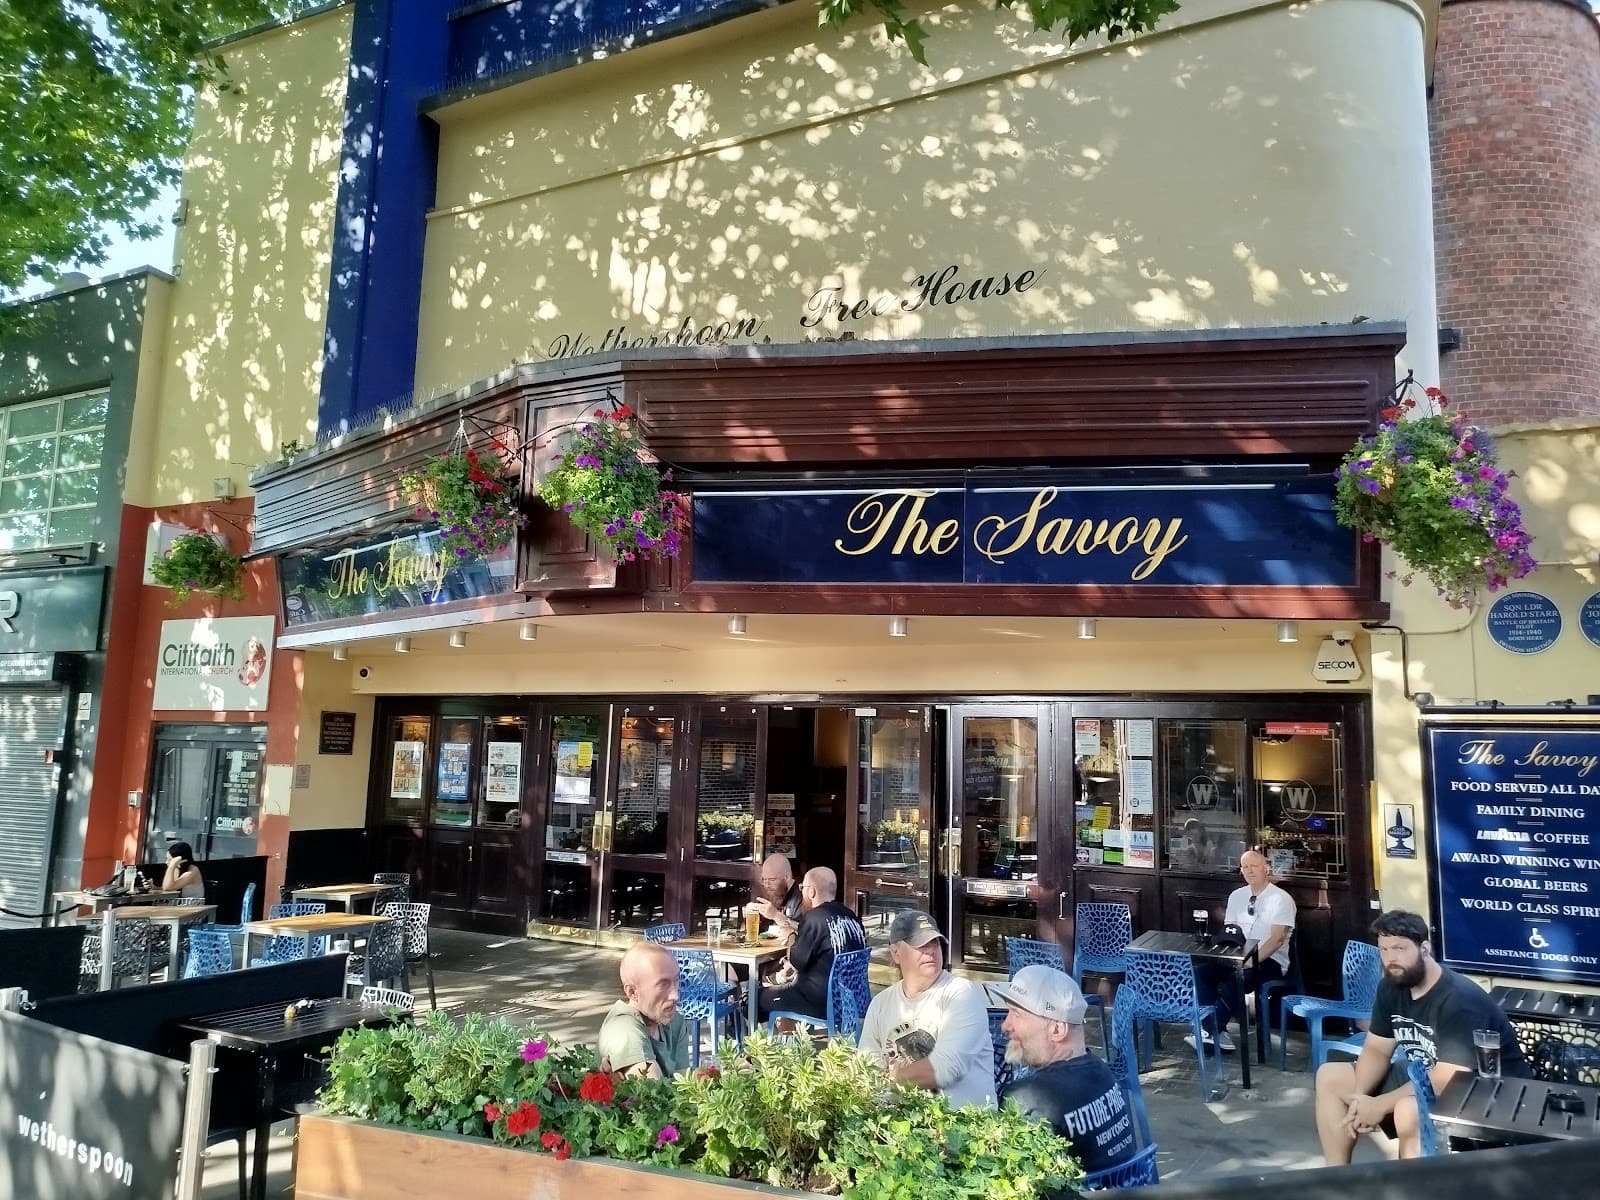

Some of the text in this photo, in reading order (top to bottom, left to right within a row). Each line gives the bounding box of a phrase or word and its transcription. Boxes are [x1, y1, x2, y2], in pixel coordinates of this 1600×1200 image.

[800, 287, 899, 328] Free
[901, 265, 1047, 312] House
[835, 486, 1188, 581] The Savoy
[328, 547, 368, 600] The
[1490, 610, 1559, 619] HAROLD STARR
[1503, 603, 1542, 612] SQN LDR
[163, 643, 235, 667] Citifaith
[1318, 660, 1356, 670] SECOM
[1458, 739, 1598, 778] The Savoy
[1191, 784, 1214, 805] W
[1451, 781, 1600, 796] FOOD SERVED ALL DA
[1286, 787, 1310, 809] W
[1476, 805, 1585, 818] FAMILY DINING
[1533, 832, 1590, 845] COFFEE
[1451, 852, 1500, 864] AWARD
[1502, 855, 1571, 868] WINNING
[1484, 876, 1588, 893] GLOBAL BEERS
[1460, 898, 1513, 911] WORLD
[1516, 902, 1559, 915] CLASS
[1485, 948, 1597, 964] ASSISTANCE DOGS ONLY
[1064, 1095, 1111, 1138] FUTURE
[18, 1114, 134, 1187] wetherspoon
